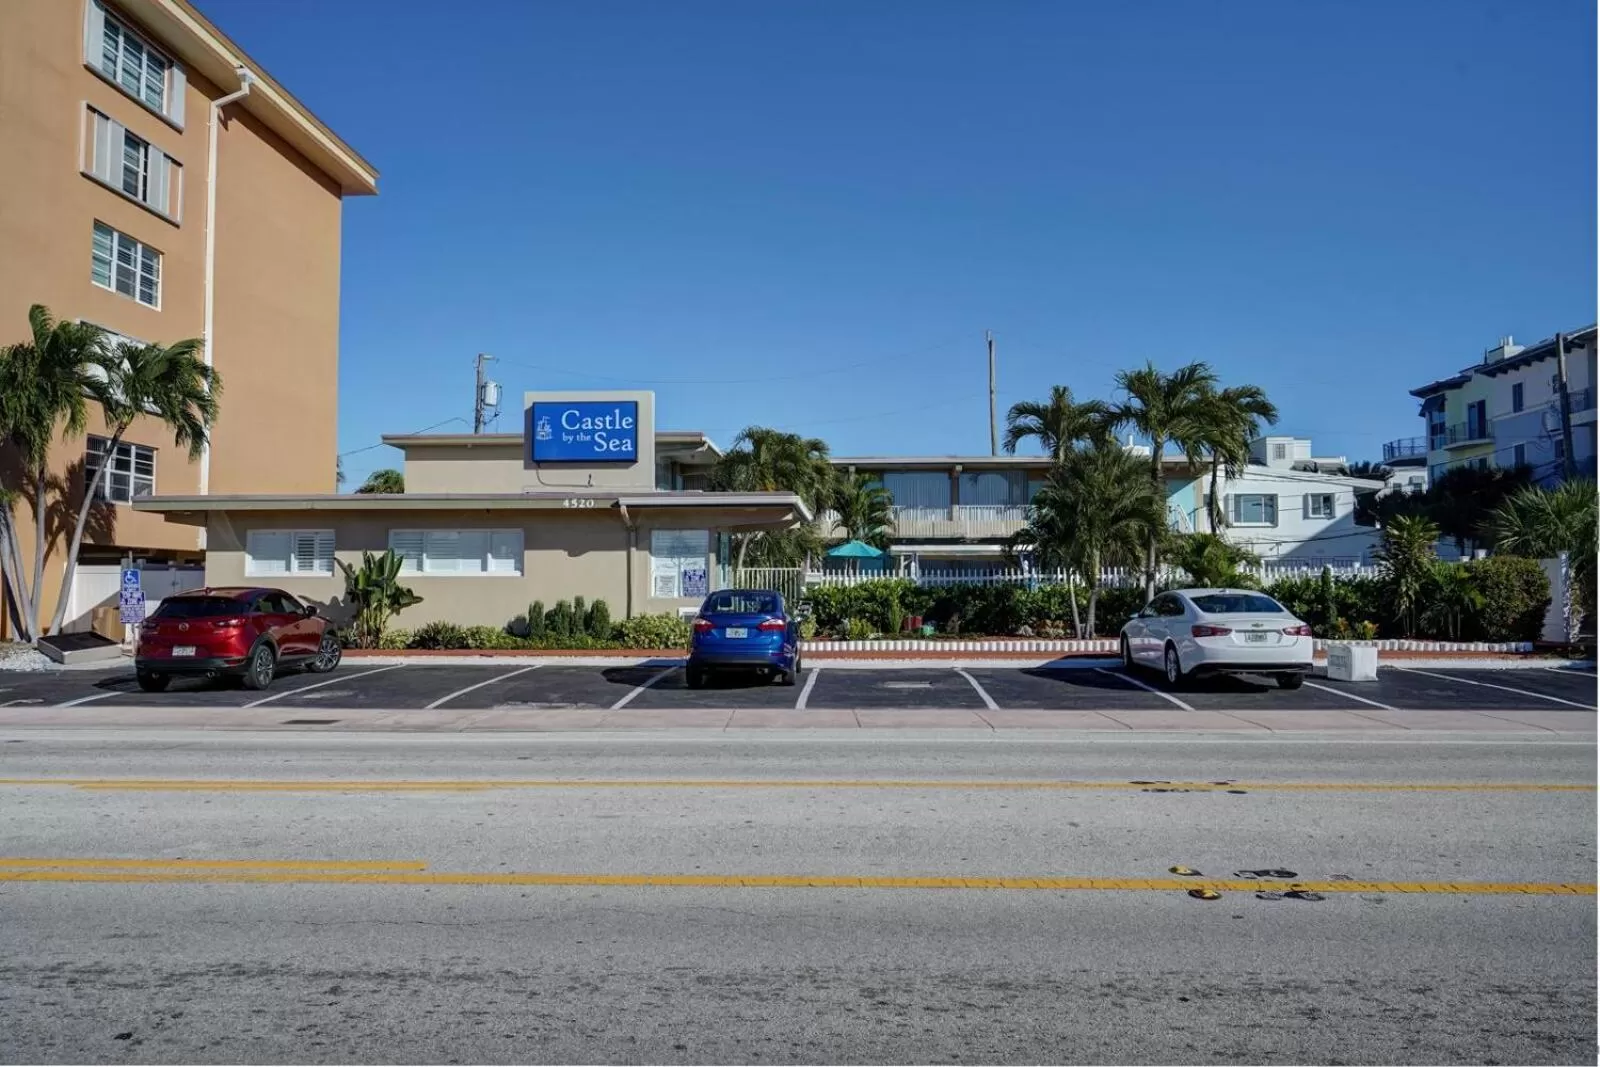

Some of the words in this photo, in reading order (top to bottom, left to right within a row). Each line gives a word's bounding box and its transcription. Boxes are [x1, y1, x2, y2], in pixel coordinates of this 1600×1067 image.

[562, 409, 633, 430] Castle
[562, 432, 574, 444] by
[576, 432, 591, 442] the
[594, 432, 633, 452] Sea
[562, 498, 595, 508] 4520
